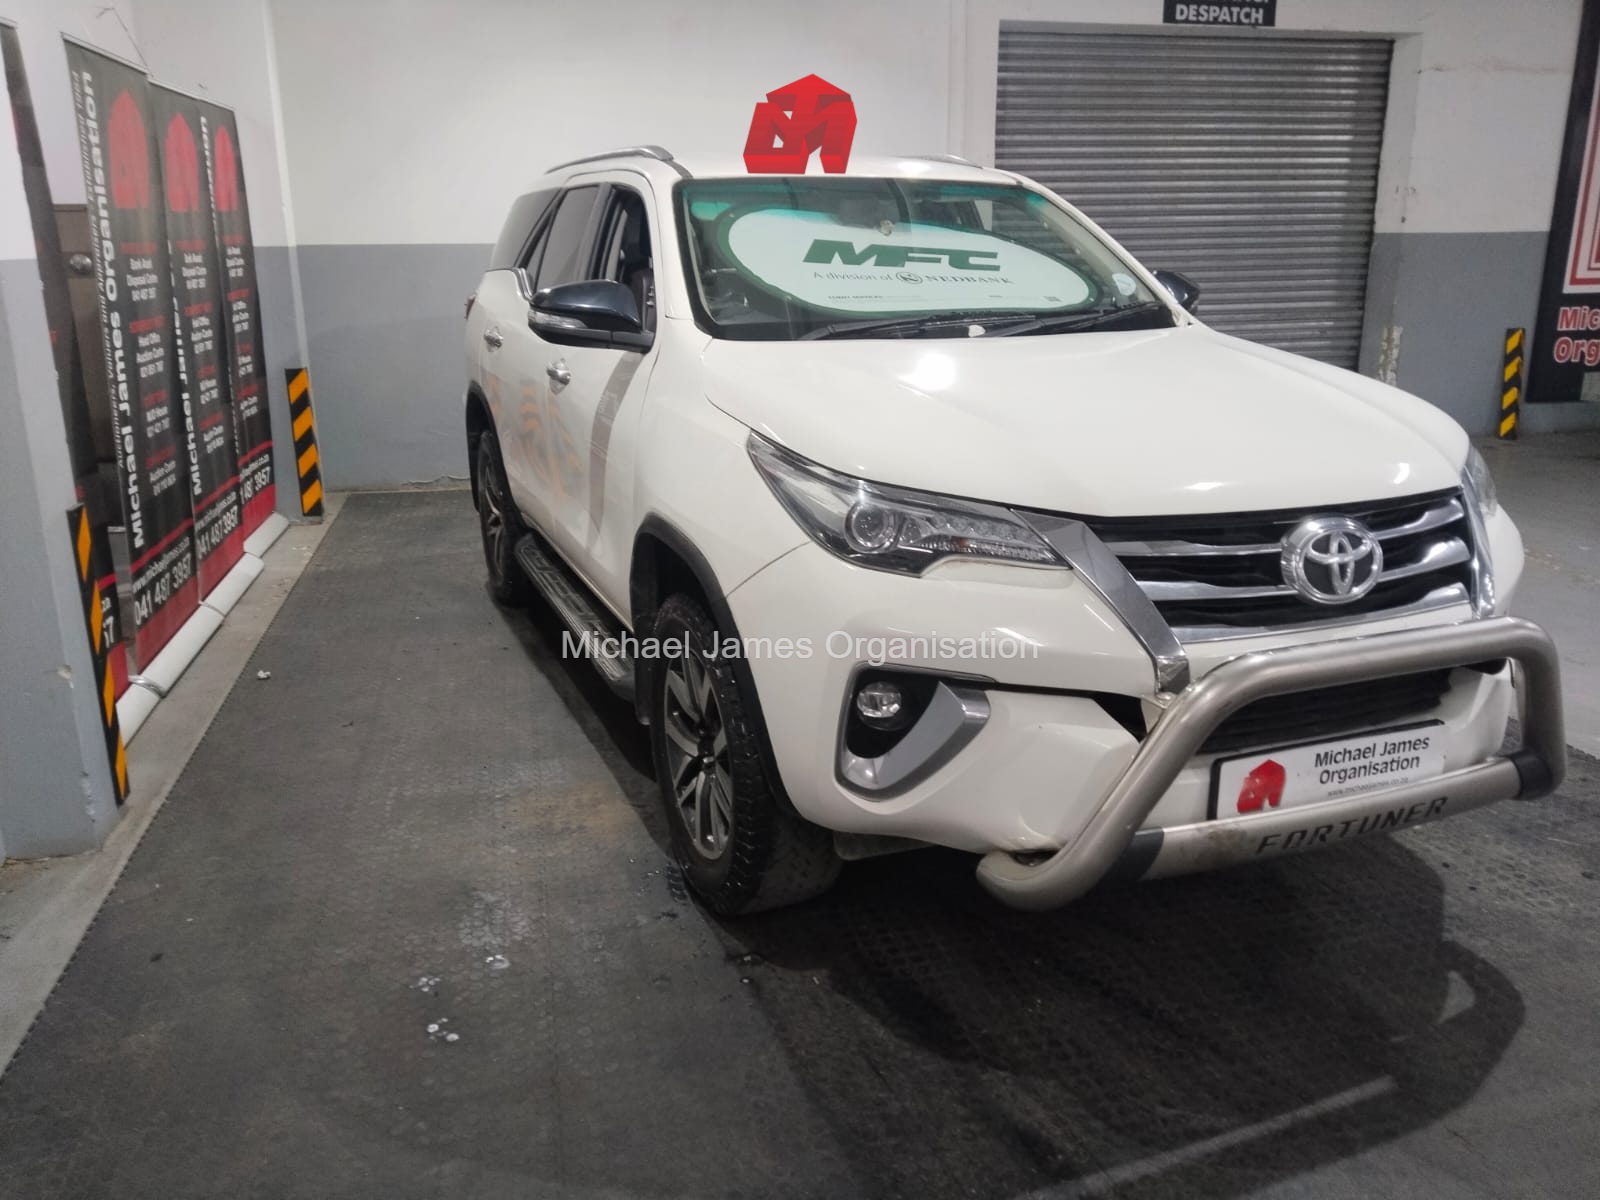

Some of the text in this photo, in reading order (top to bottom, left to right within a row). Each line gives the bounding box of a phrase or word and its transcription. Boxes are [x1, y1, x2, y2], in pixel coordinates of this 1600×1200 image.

[1175, 4, 1264, 24] DESPATCH
[803, 239, 1001, 271] MFC
[813, 271, 1015, 285] A division of NEDBANK
[82, 71, 145, 549] Michael James Organisation
[182, 392, 202, 496] Michael
[134, 552, 192, 626] 041 487 3957
[1315, 737, 1430, 768] Michael James
[1320, 756, 1420, 785] Organisation
[1256, 796, 1449, 856] FORTUNER
